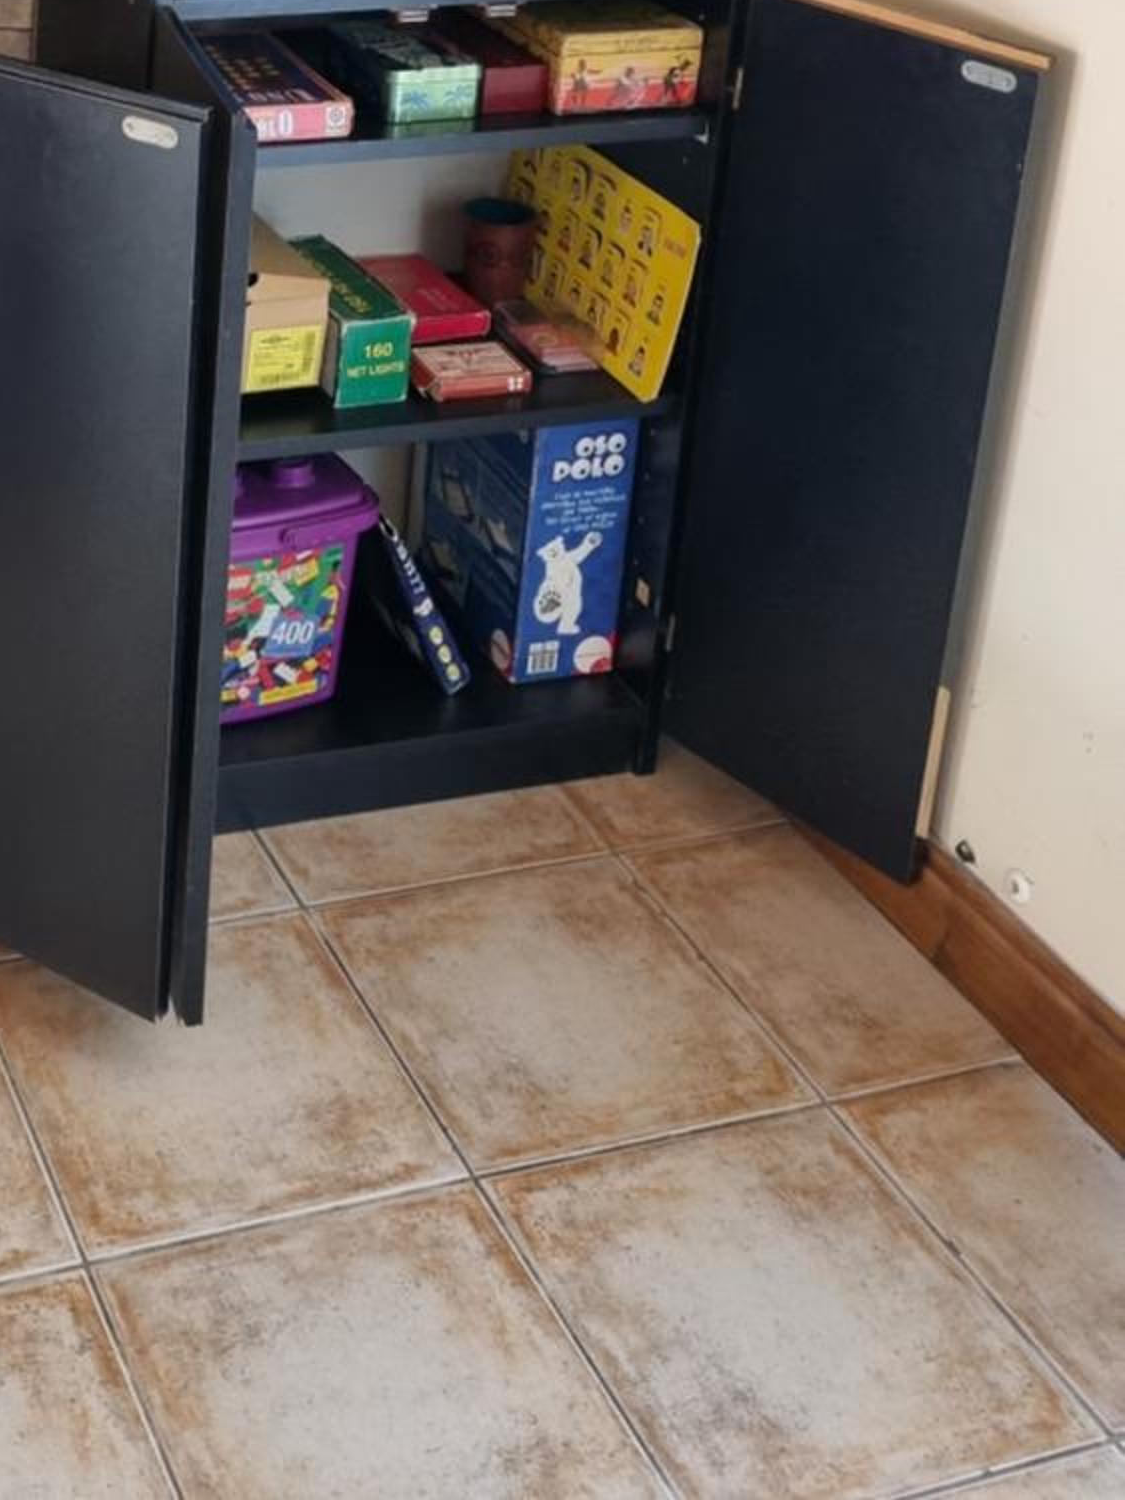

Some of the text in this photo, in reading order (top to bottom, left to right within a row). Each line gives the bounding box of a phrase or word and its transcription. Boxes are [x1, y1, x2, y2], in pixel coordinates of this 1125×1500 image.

[364, 342, 393, 358] 160
[347, 366, 366, 378] NET
[576, 433, 627, 457] OSO
[552, 454, 625, 483] POLO
[272, 622, 315, 645] 400
